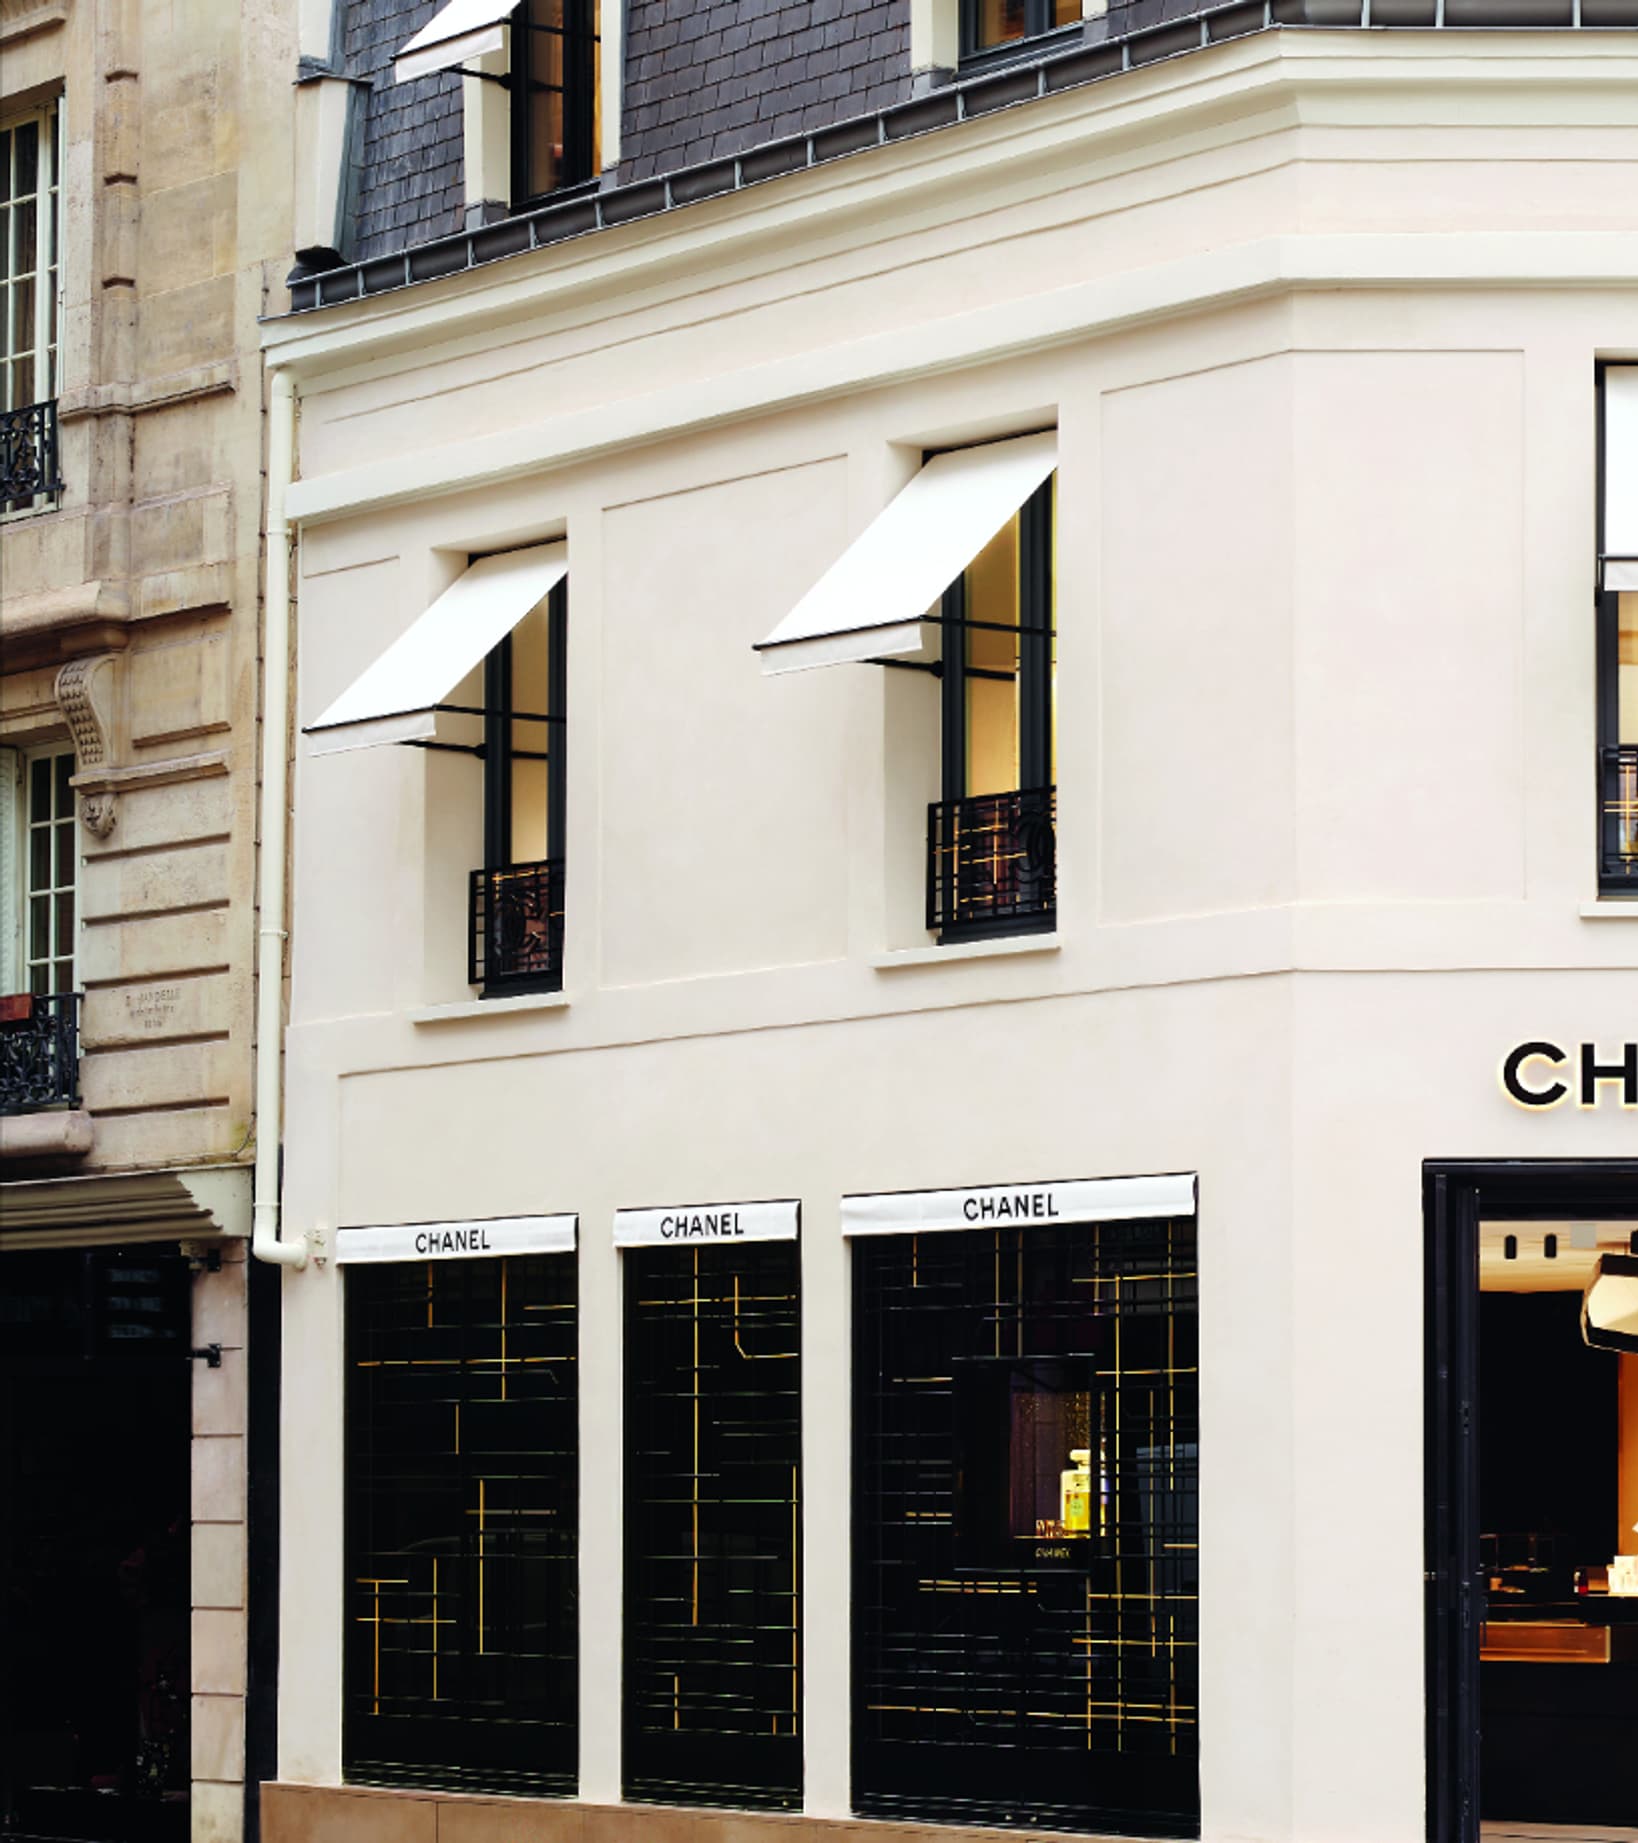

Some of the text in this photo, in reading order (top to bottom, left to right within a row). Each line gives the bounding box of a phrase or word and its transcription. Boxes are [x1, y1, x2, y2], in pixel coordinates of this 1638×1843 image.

[963, 1193, 1060, 1221] CHANEL
[660, 1212, 745, 1239] CHANEL
[415, 1229, 491, 1254] CHANEL
